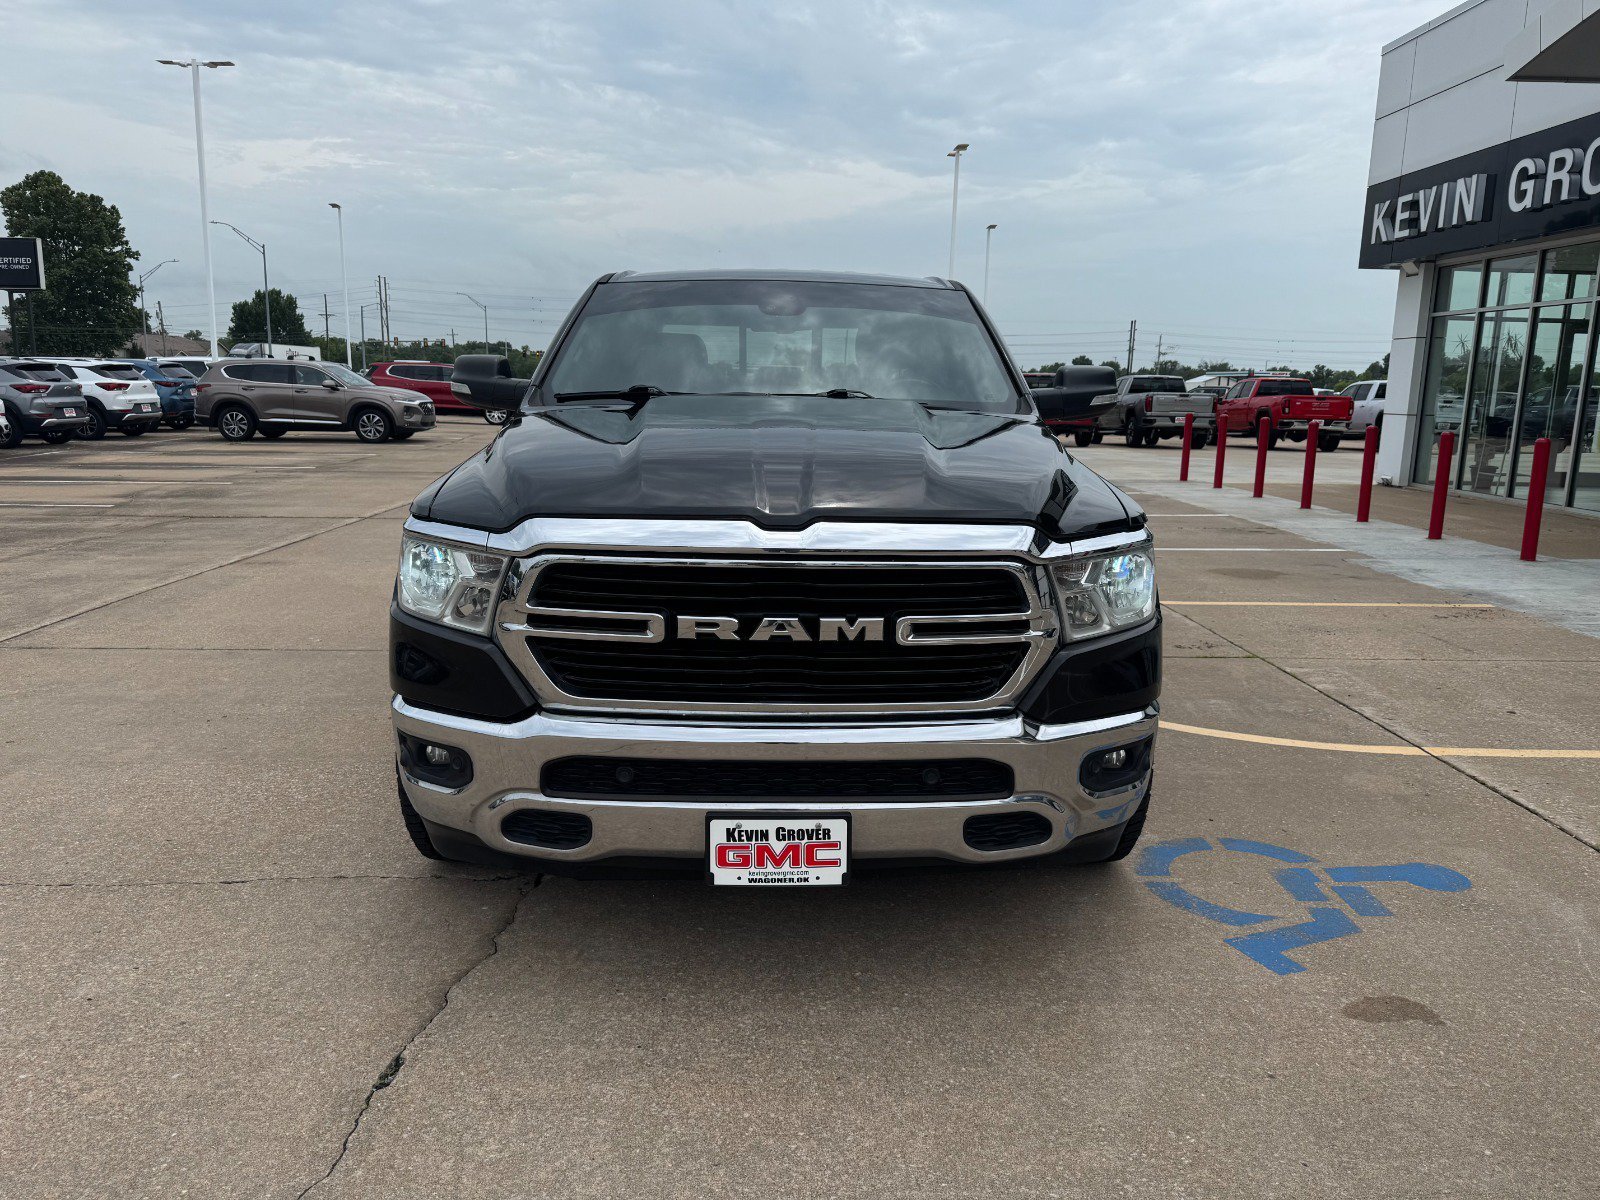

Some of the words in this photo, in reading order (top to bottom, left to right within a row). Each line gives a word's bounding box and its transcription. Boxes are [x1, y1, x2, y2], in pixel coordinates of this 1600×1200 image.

[1370, 173, 1487, 245] KEVIN
[677, 615, 885, 642] RAM
[716, 841, 842, 869] GMC
